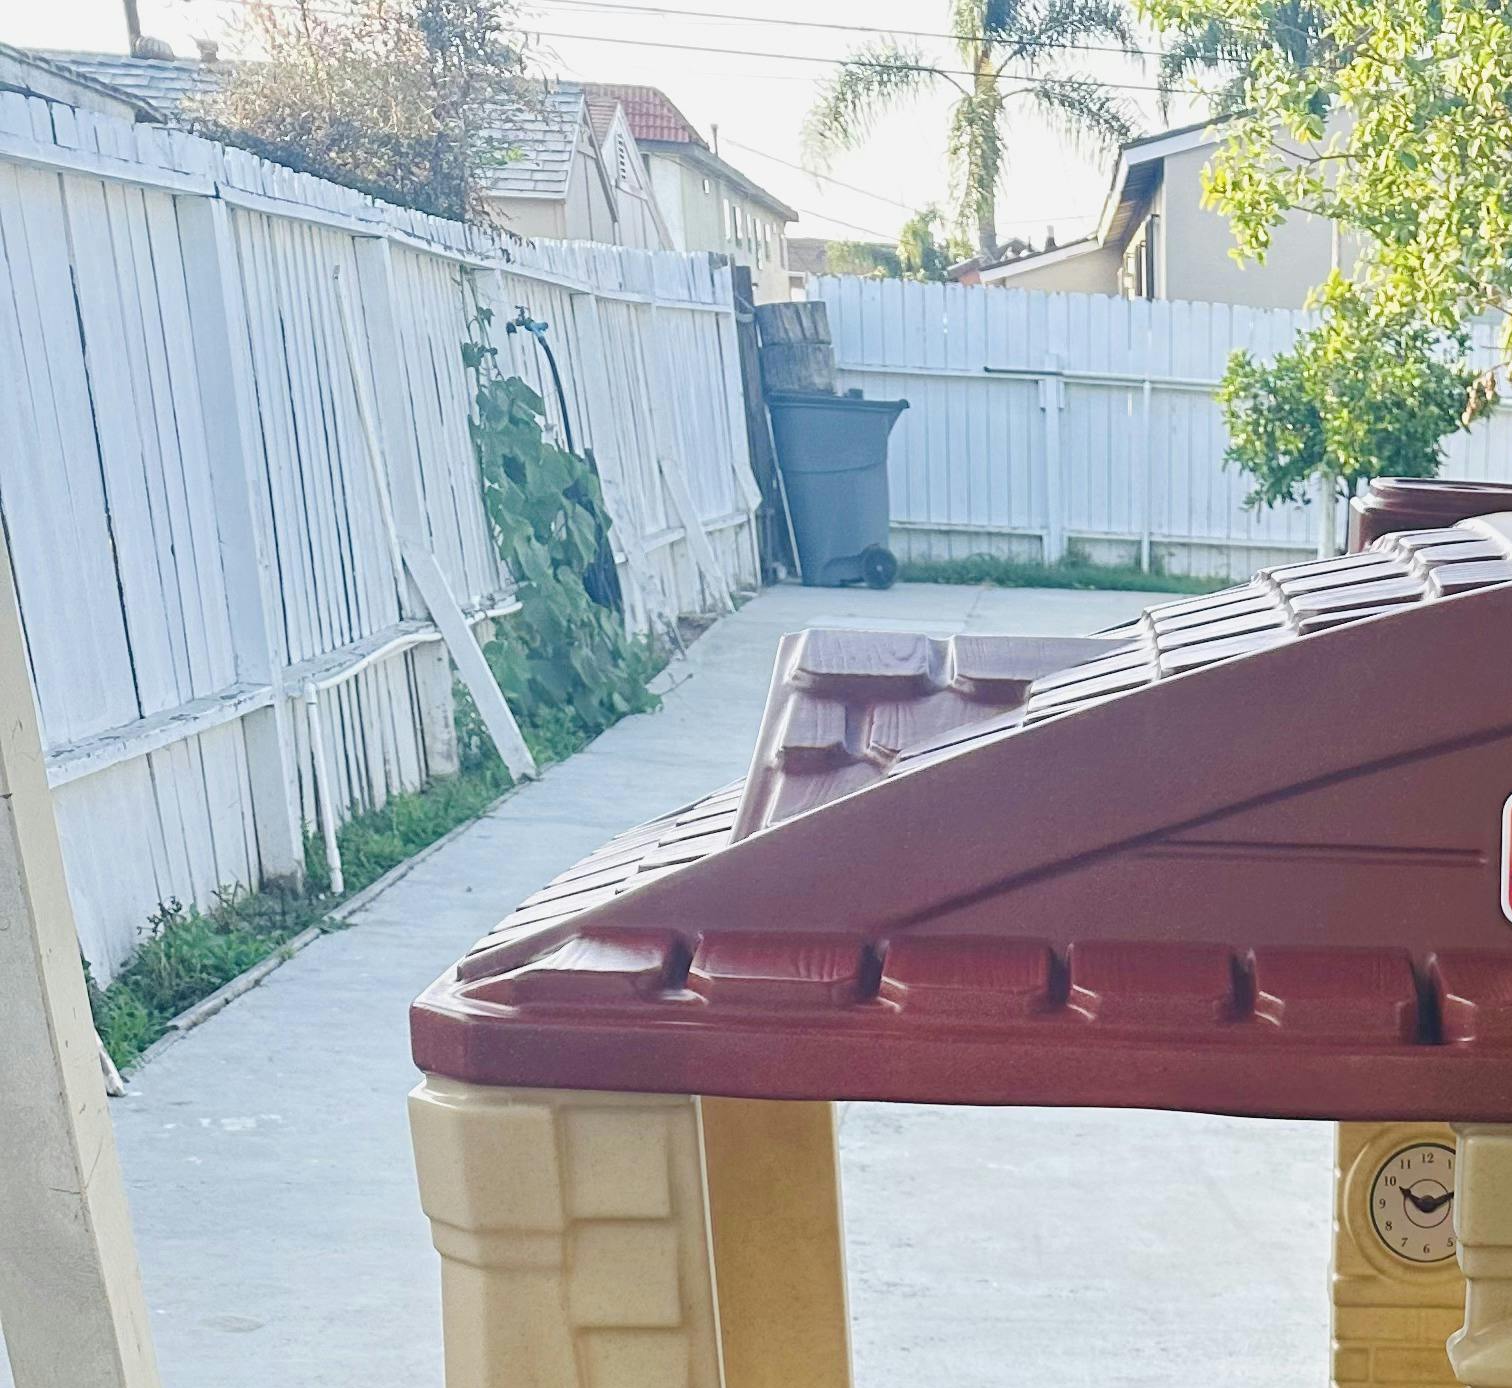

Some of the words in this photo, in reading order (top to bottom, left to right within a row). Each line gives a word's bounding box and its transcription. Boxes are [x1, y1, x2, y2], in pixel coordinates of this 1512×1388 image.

[1421, 1152, 1434, 1164] 12
[1400, 1159, 1411, 1170] 11
[1384, 1175, 1397, 1187] 10
[1379, 1198, 1386, 1209] 9
[1385, 1221, 1393, 1231] 8
[1401, 1237, 1408, 1248] 7
[1447, 1237, 1454, 1248] 5
[1423, 1243, 1431, 1254] 6
